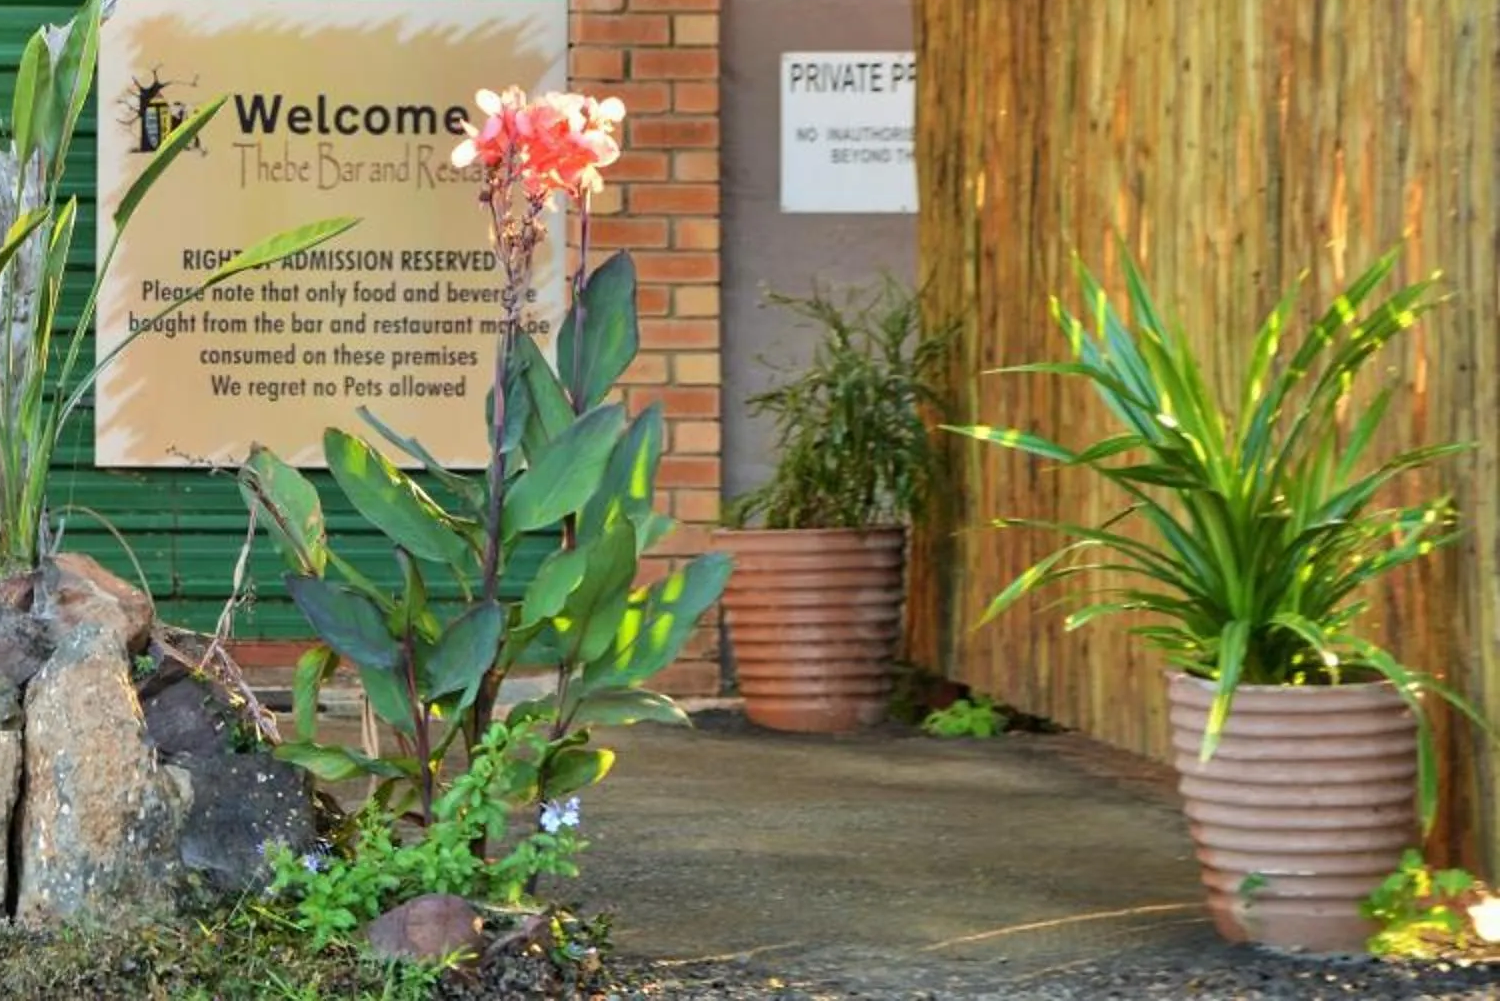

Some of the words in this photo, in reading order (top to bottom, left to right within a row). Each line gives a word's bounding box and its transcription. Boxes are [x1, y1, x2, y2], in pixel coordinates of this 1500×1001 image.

[790, 63, 883, 93] PRIVATE
[234, 94, 470, 135] Welcome
[796, 127, 819, 143] NO
[232, 141, 310, 190] Thebe
[317, 142, 362, 190] Bar
[368, 142, 411, 183] and
[831, 148, 892, 164] BEYOND
[281, 250, 394, 272] ADMISSION
[401, 250, 497, 272] RESERVED
[212, 284, 255, 302] note
[261, 280, 300, 302] that
[306, 281, 347, 308] only
[353, 281, 397, 303] food
[403, 281, 440, 303] and
[447, 281, 537, 303] bevere
[129, 311, 196, 338] bought
[203, 311, 248, 334] from
[254, 311, 285, 334] the
[291, 311, 324, 334] bar
[330, 312, 367, 334] and
[373, 316, 474, 334] restaurant
[480, 320, 518, 335] ma
[200, 343, 296, 365] consumed
[303, 350, 327, 365] on
[333, 343, 386, 366] these
[391, 346, 479, 370] premises
[211, 375, 242, 396] We
[248, 378, 307, 402] regret
[313, 381, 338, 397] no
[343, 376, 383, 397] Pets
[388, 375, 467, 397] allowed
